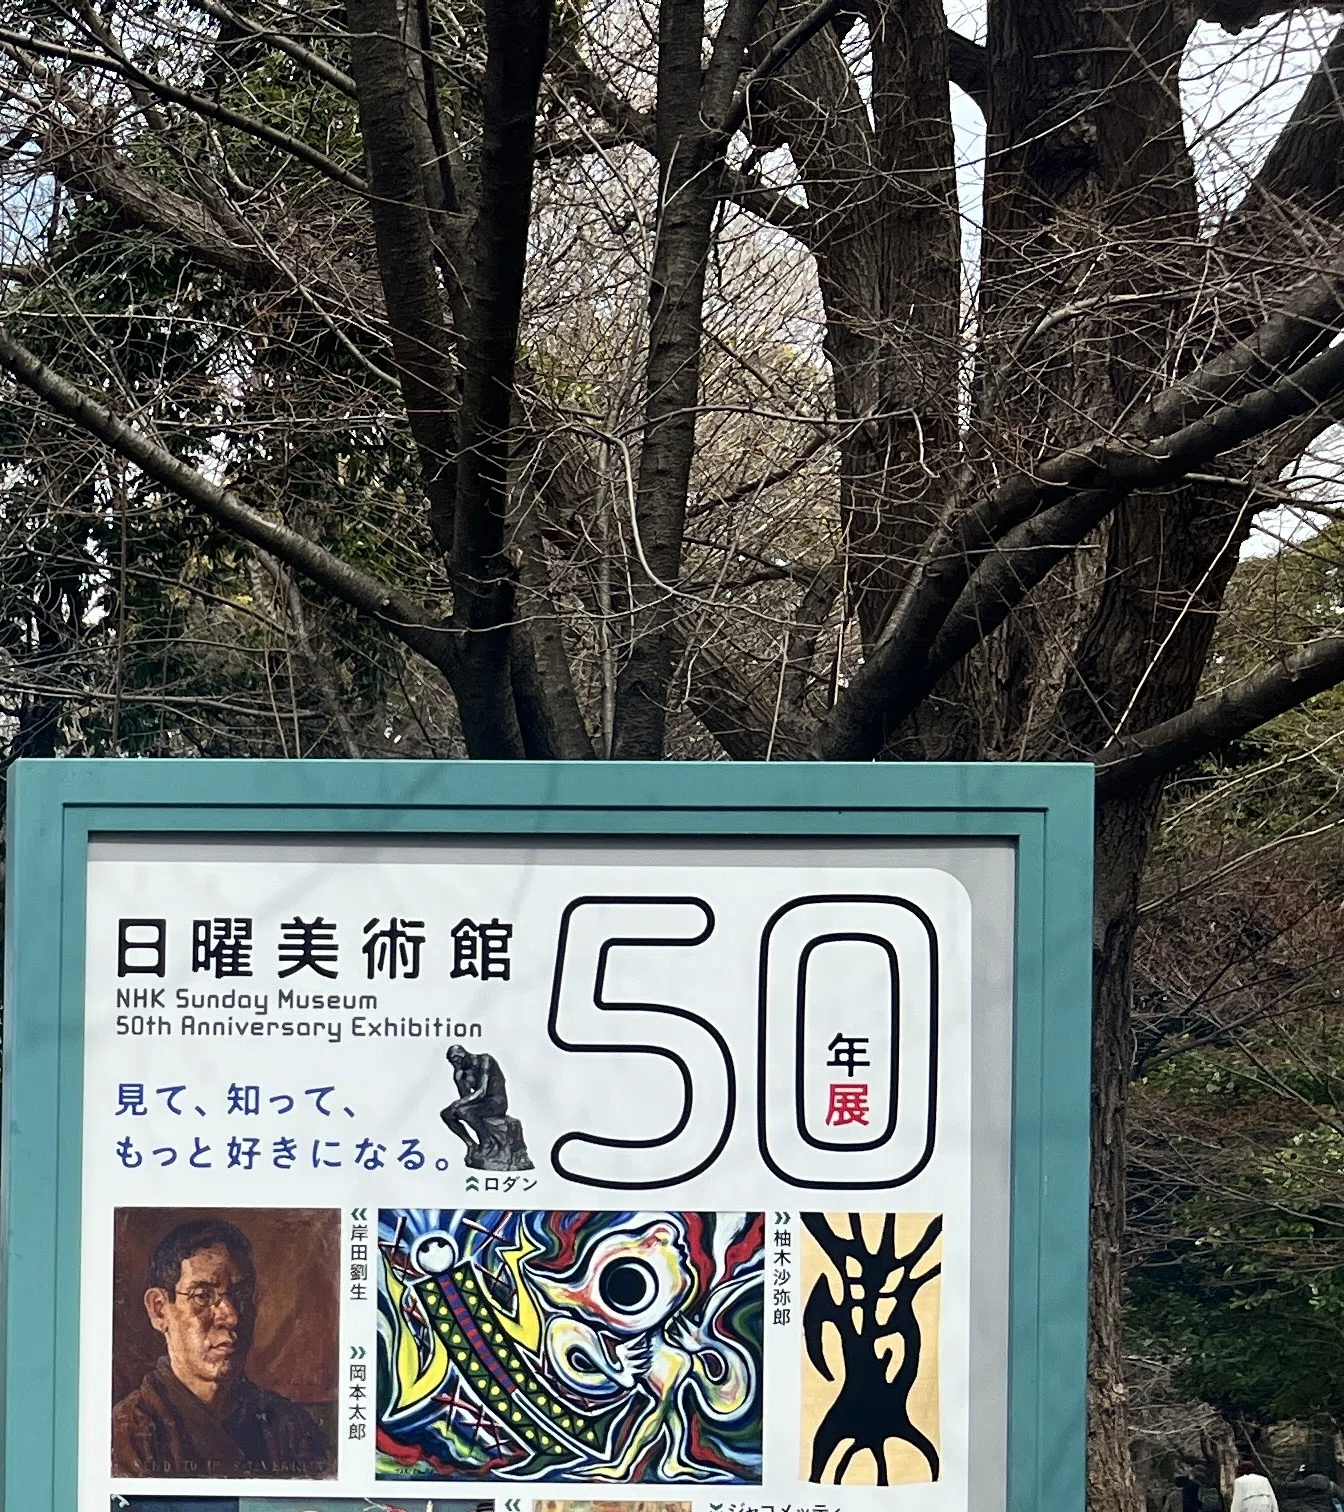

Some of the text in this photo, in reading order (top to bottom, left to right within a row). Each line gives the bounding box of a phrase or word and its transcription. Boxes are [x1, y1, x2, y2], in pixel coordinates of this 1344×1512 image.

[117, 916, 513, 981] 日曜美術館
[116, 988, 378, 1015] NHK Sunday Museum
[116, 1015, 482, 1043] 50th Anniversary Exhibition
[547, 894, 939, 1191] 50
[115, 1083, 355, 1118] 見て、知って、
[115, 1137, 449, 1172] もっと好きになる。
[484, 1176, 538, 1193] ロダン
[350, 1224, 368, 1301] 岸田劉生
[772, 1229, 791, 1326] 柚木沙弥郎
[348, 1364, 367, 1441] 岡本太郎
